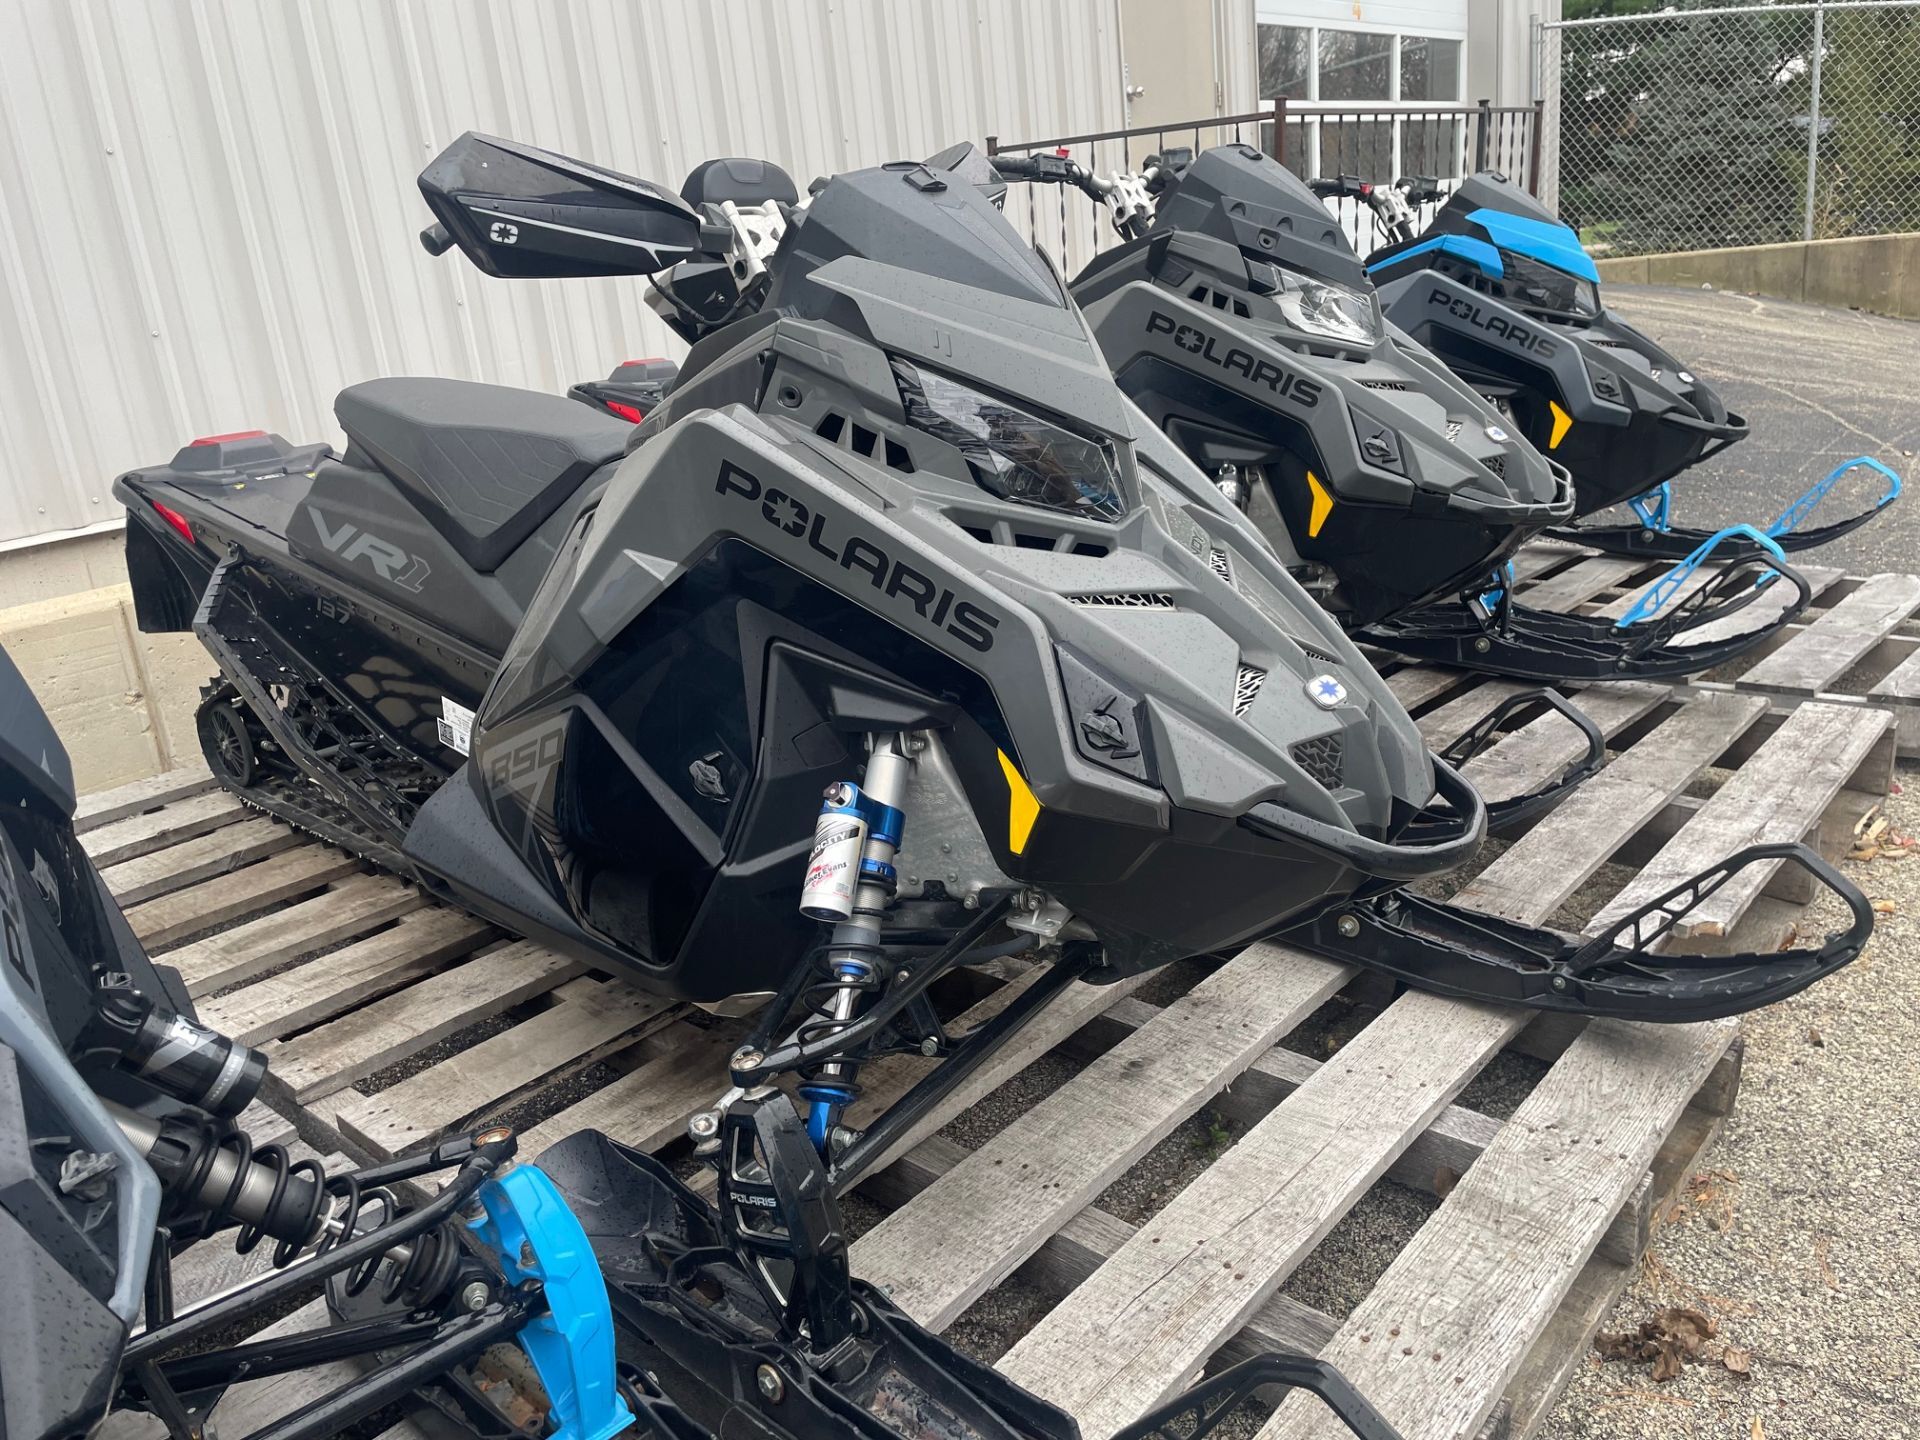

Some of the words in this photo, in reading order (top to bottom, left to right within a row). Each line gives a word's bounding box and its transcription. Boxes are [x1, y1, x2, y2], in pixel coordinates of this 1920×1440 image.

[1428, 289, 1558, 359] POLARIS
[1145, 310, 1323, 408] POLARIS
[307, 505, 431, 593] VR1
[715, 458, 1000, 653] POLARIS
[316, 597, 352, 624] 137
[491, 728, 564, 790] 850
[808, 831, 847, 861] LOCITY
[730, 1192, 777, 1208] POLARIS
